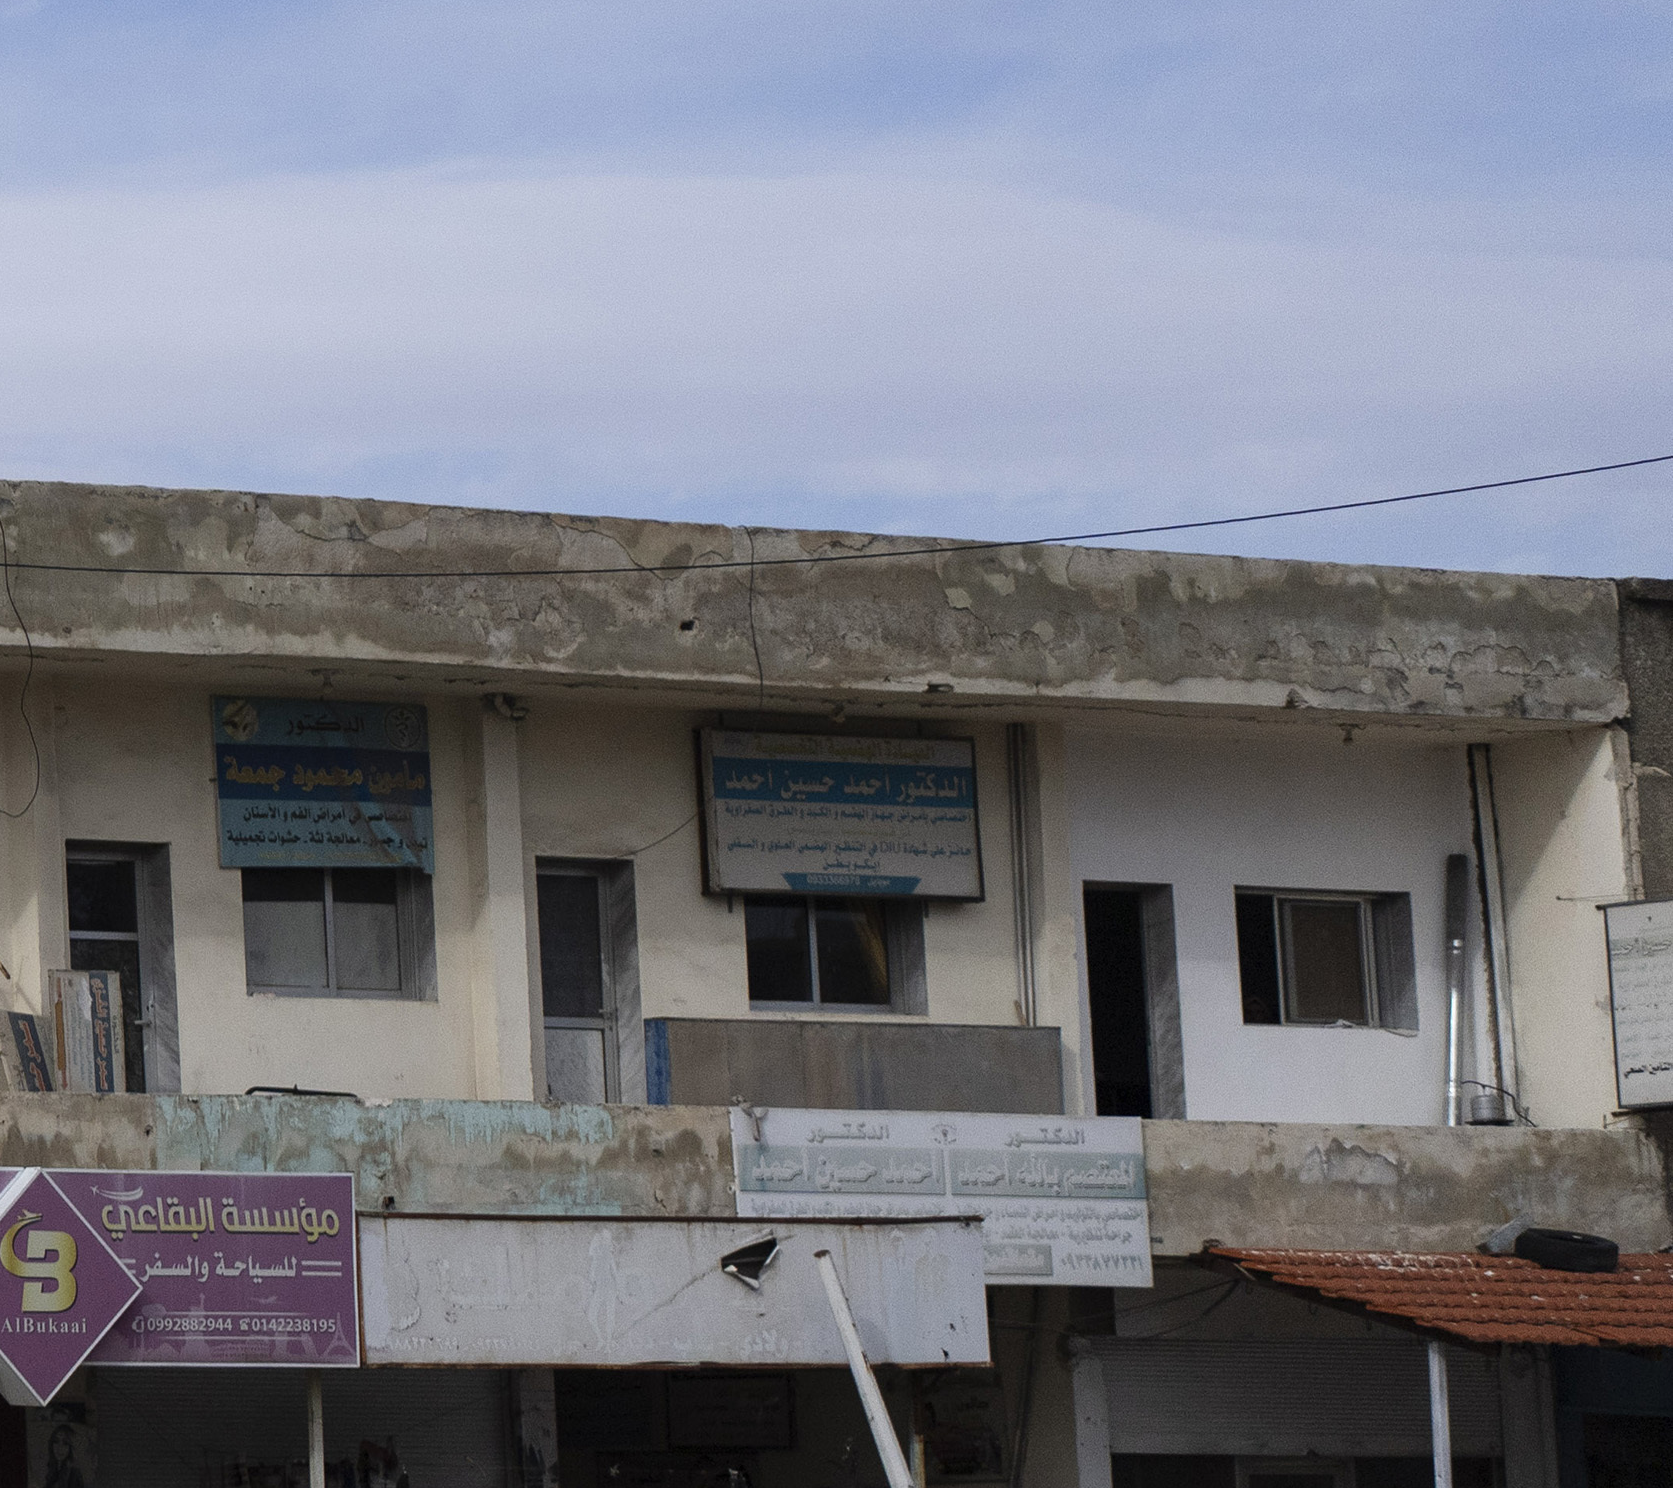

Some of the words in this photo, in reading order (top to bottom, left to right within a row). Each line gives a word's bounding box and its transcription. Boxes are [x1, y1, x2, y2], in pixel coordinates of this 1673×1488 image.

[224, 755, 285, 792] جمعة
[293, 764, 363, 792] محمود
[726, 768, 773, 791] أحمد
[781, 769, 835, 800] حسين
[844, 771, 891, 795] أحمد
[896, 771, 967, 804] الدكتور
[806, 1123, 890, 1143] الدكتور
[1005, 1126, 1085, 1148] الدكتور
[958, 1150, 1014, 1188] أحمد
[101, 1196, 216, 1242] البقاعي
[222, 1197, 340, 1244] مؤسسة
[139, 1251, 211, 1282] والسفر
[213, 1251, 298, 1284] للسياحة
[0, 1317, 88, 1334] AlBukaai
[147, 1316, 233, 1334] 0992882944
[251, 1318, 336, 1333] 0142238195
